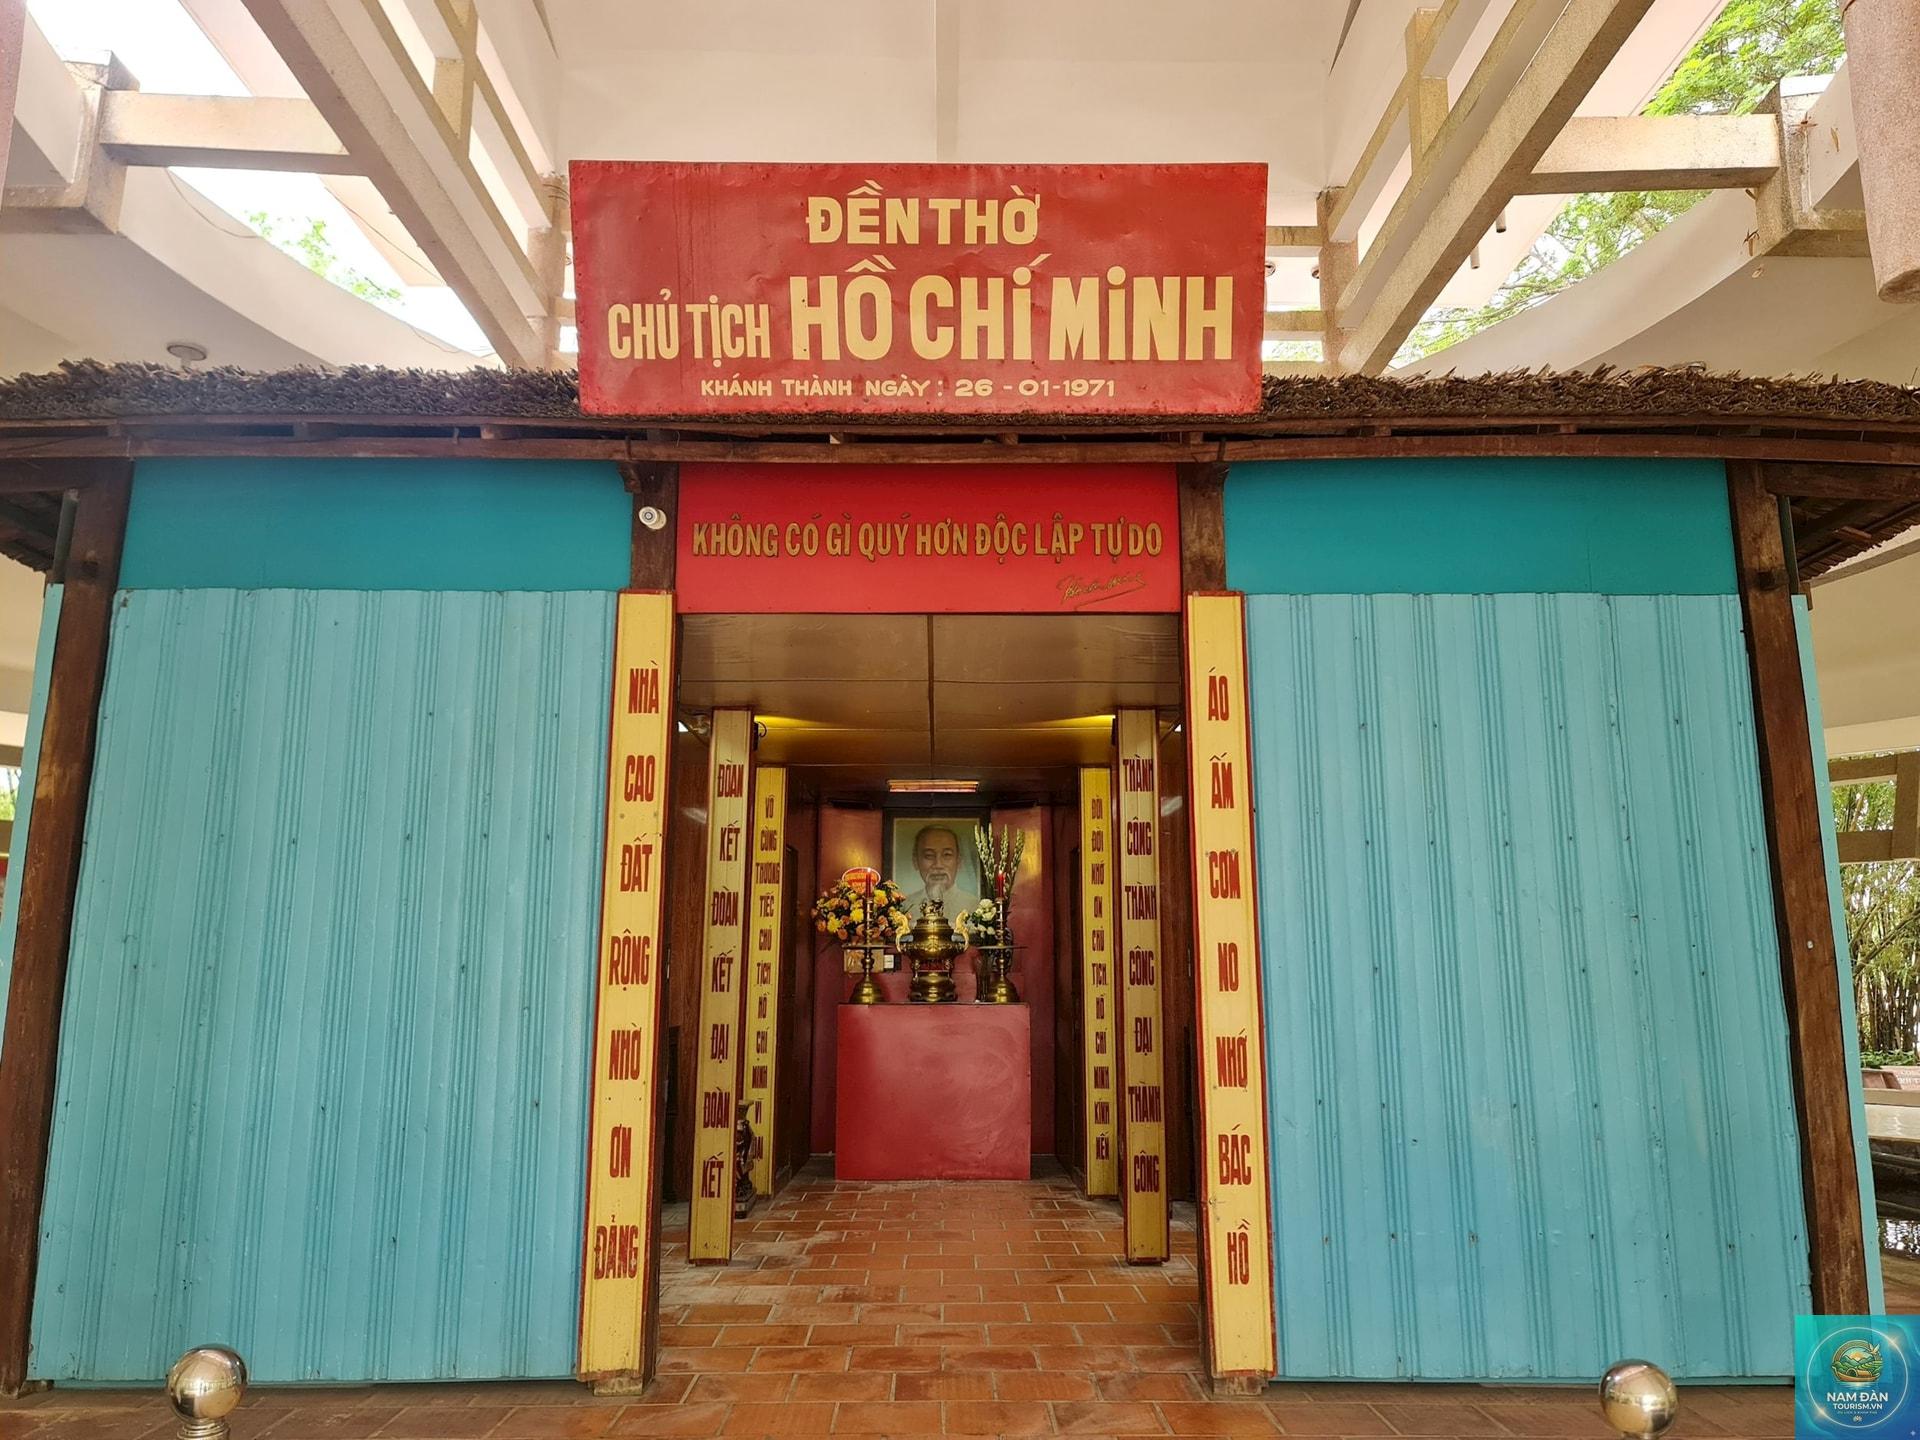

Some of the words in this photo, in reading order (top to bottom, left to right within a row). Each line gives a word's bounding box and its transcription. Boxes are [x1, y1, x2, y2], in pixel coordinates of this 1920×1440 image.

[805, 180, 920, 245] ĐỀN
[928, 185, 1041, 245] THỜ
[607, 288, 679, 360] CHỦ
[789, 254, 897, 361] HỒ
[701, 373, 773, 397] KHÁNH
[780, 373, 853, 397] THÀNH
[865, 373, 931, 397] NGÀY
[954, 378, 993, 397] 26
[692, 513, 779, 558] KHÔNG
[785, 514, 821, 557] CÓ
[825, 514, 852, 557] GÌ
[858, 513, 909, 561] QUÝ
[915, 517, 969, 557] HƠN
[974, 514, 1028, 563] ĐỘC
[1034, 514, 1085, 563] LẬP
[1090, 516, 1125, 563] TỰ
[1128, 522, 1163, 556] DO
[628, 660, 659, 714] NHÀ
[1208, 666, 1230, 722] ÁO
[624, 755, 656, 802] CAO
[1122, 753, 1154, 792] THÀNH
[1210, 752, 1235, 809] ẤM
[719, 820, 740, 861] KẾT
[1127, 816, 1152, 856] CÔNG
[620, 833, 653, 892] ĐẤT
[1208, 849, 1241, 899] CƠM
[711, 885, 739, 926] ĐOÀN
[1124, 881, 1157, 920] THÀNH
[608, 928, 651, 991] RỘNG
[711, 949, 733, 993] KẾT
[1129, 945, 1155, 986] CÔNG
[1217, 943, 1239, 992] NO
[608, 1022, 642, 1080] NHỜ
[710, 1023, 729, 1064] ĐẠI
[1133, 1017, 1153, 1056] ĐẠI
[1216, 1028, 1248, 1088] NHỚ
[703, 1086, 730, 1129] ĐOÀN
[1128, 1081, 1162, 1123] THÀNH
[609, 1123, 632, 1178] ƠN
[701, 1152, 724, 1198] KẾT
[1133, 1150, 1160, 1193] CÔNG
[1218, 1124, 1252, 1185] BÁC
[593, 1214, 639, 1280] ĐẢNG
[1226, 1219, 1251, 1285] HỒ
